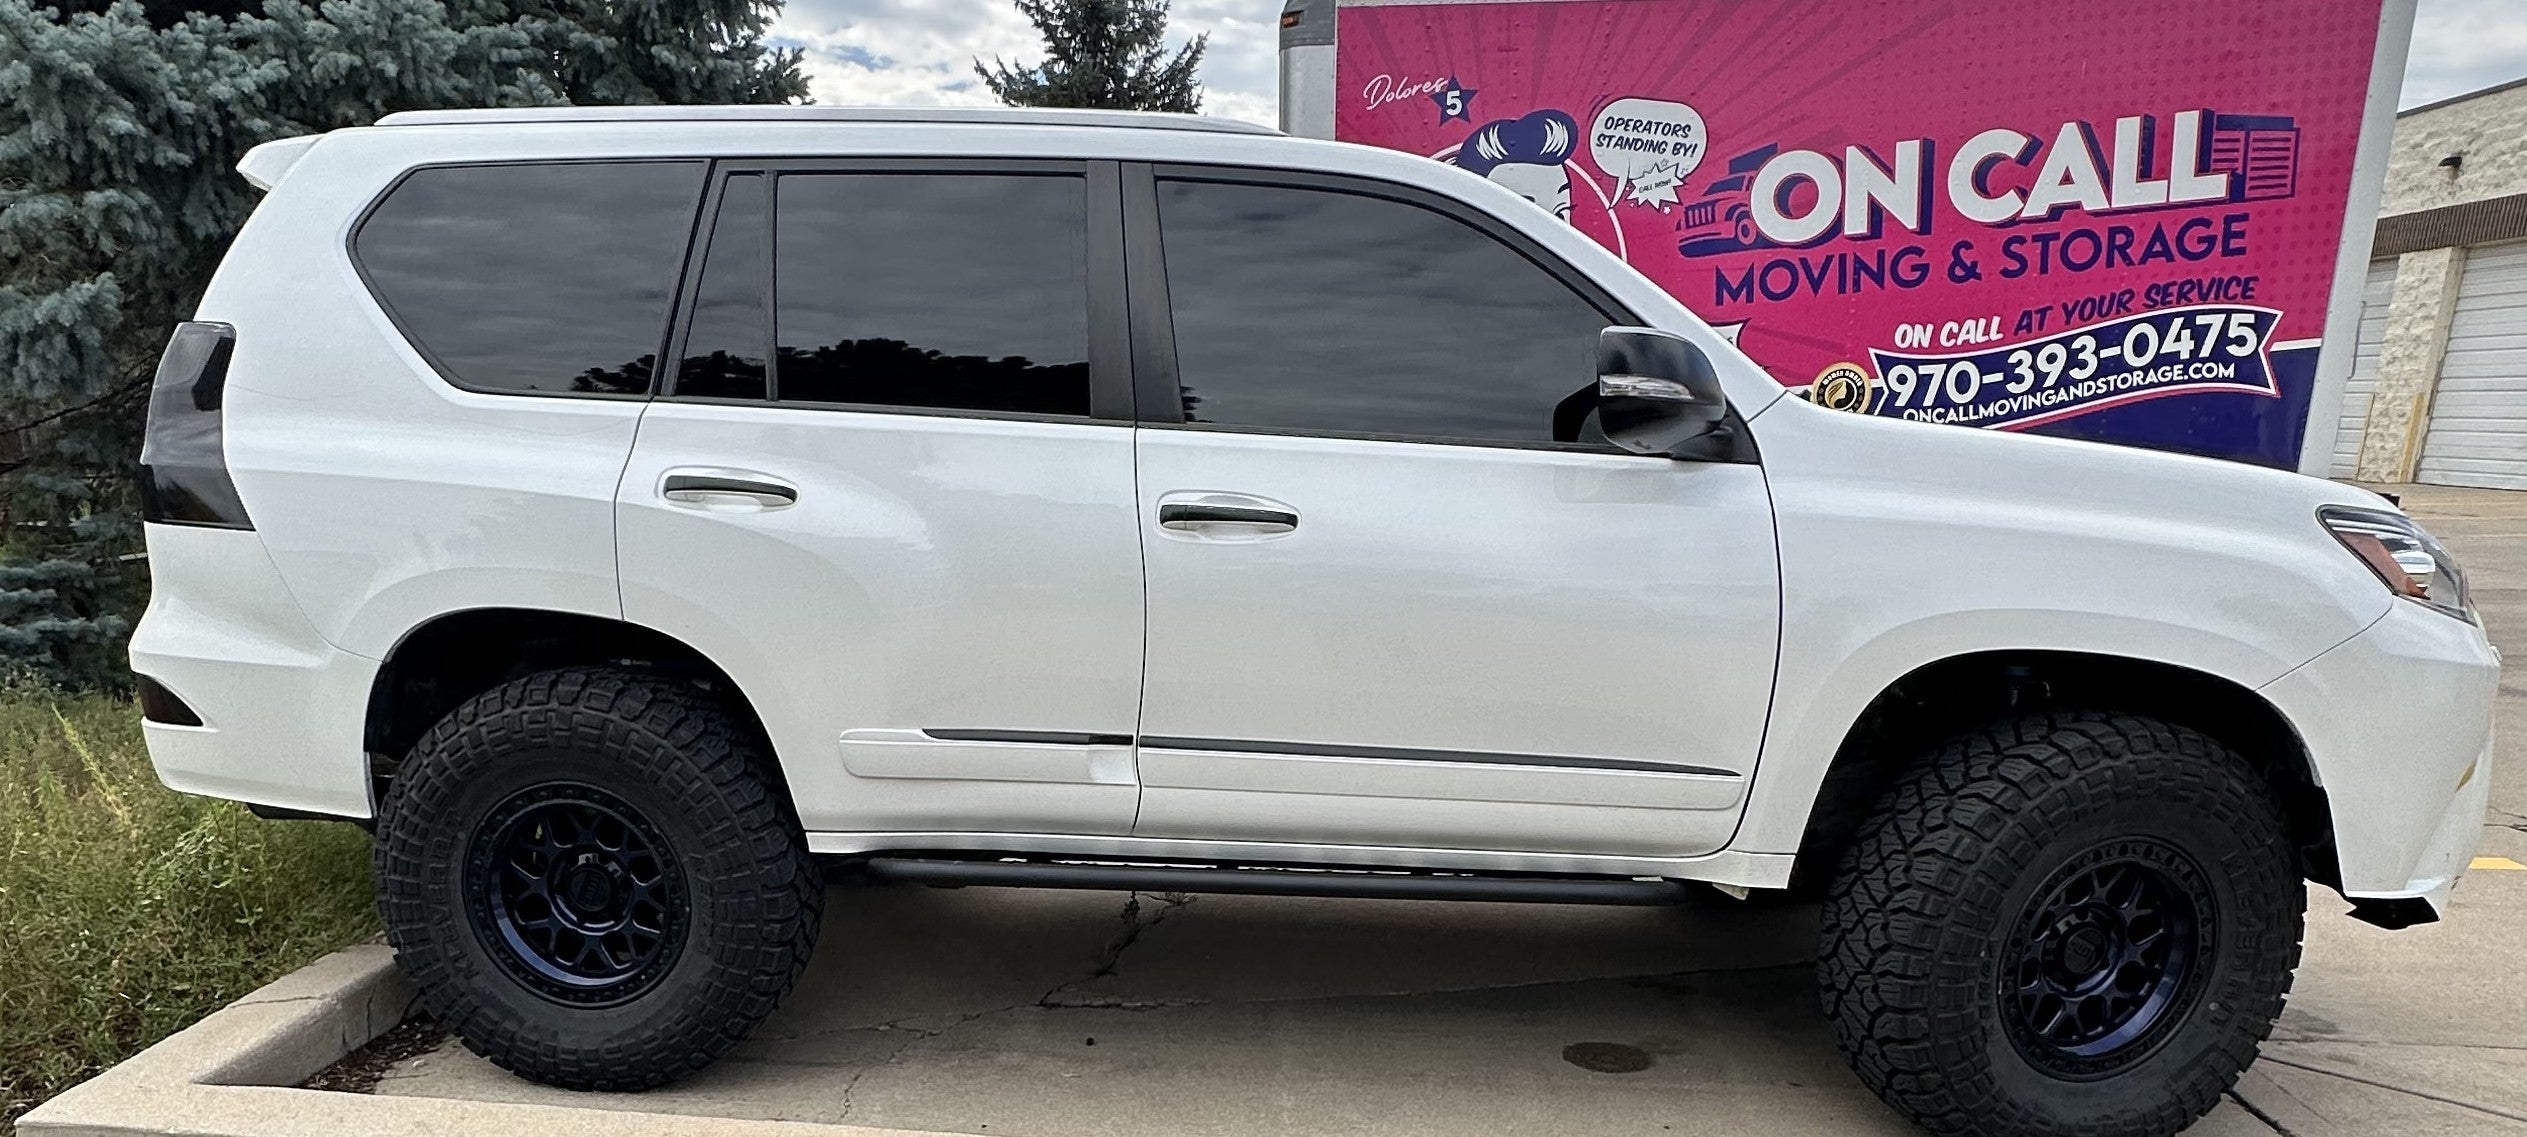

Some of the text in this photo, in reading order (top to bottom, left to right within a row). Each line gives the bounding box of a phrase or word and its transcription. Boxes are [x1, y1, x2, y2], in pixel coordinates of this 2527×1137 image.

[1363, 74, 1449, 111] Dolores
[1446, 89, 1463, 116] 5
[1596, 133, 1698, 158] STANDING BY!
[1604, 116, 1692, 139] OPERATORS
[1750, 109, 2231, 244] ON CALL
[1714, 212, 2250, 307] MOVING & STORAGE
[1894, 276, 2260, 349] ON CALL AT YOUR SERVICE
[1887, 312, 2258, 407] 970-393-0475
[1902, 361, 2235, 424] ONCALLMOVINGANDSTORAGE.COM
